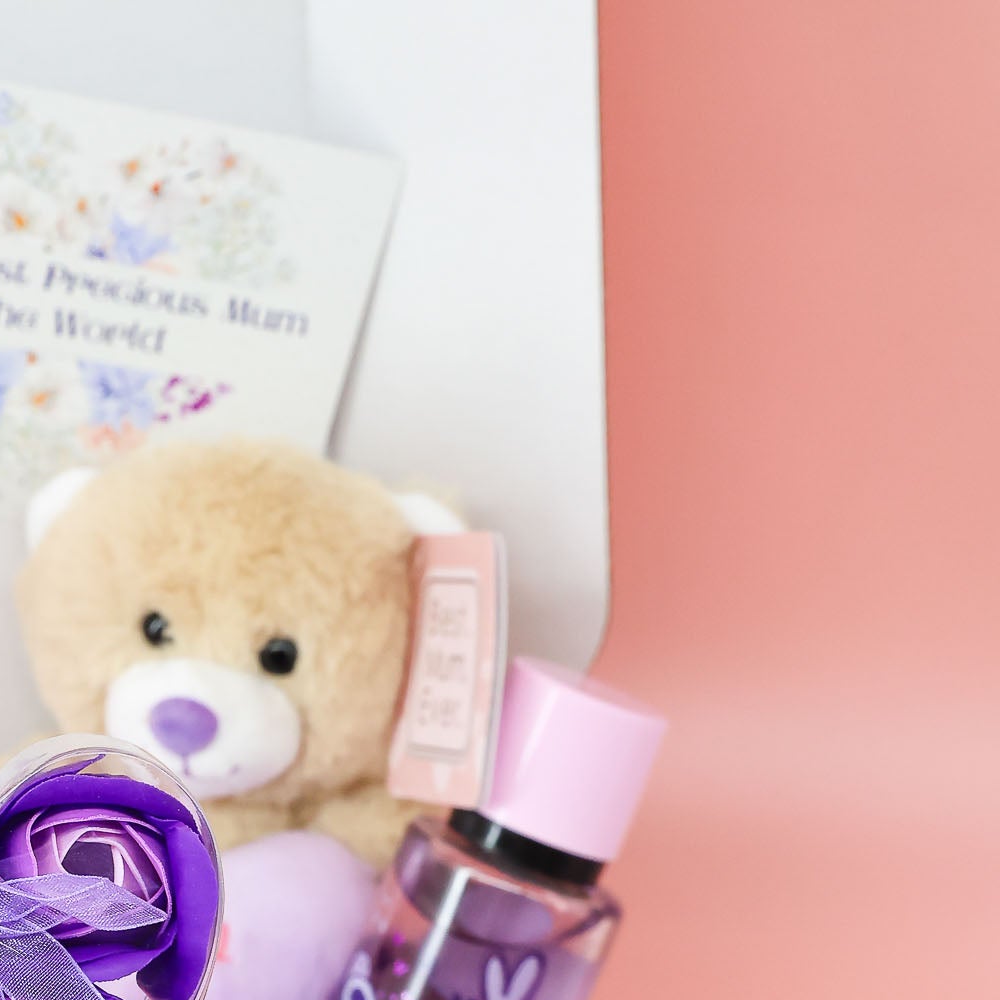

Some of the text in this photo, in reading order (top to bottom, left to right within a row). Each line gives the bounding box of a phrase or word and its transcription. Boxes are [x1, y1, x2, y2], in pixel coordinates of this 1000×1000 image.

[43, 263, 210, 319] Precious
[219, 300, 312, 338] Mum
[52, 307, 169, 355] World
